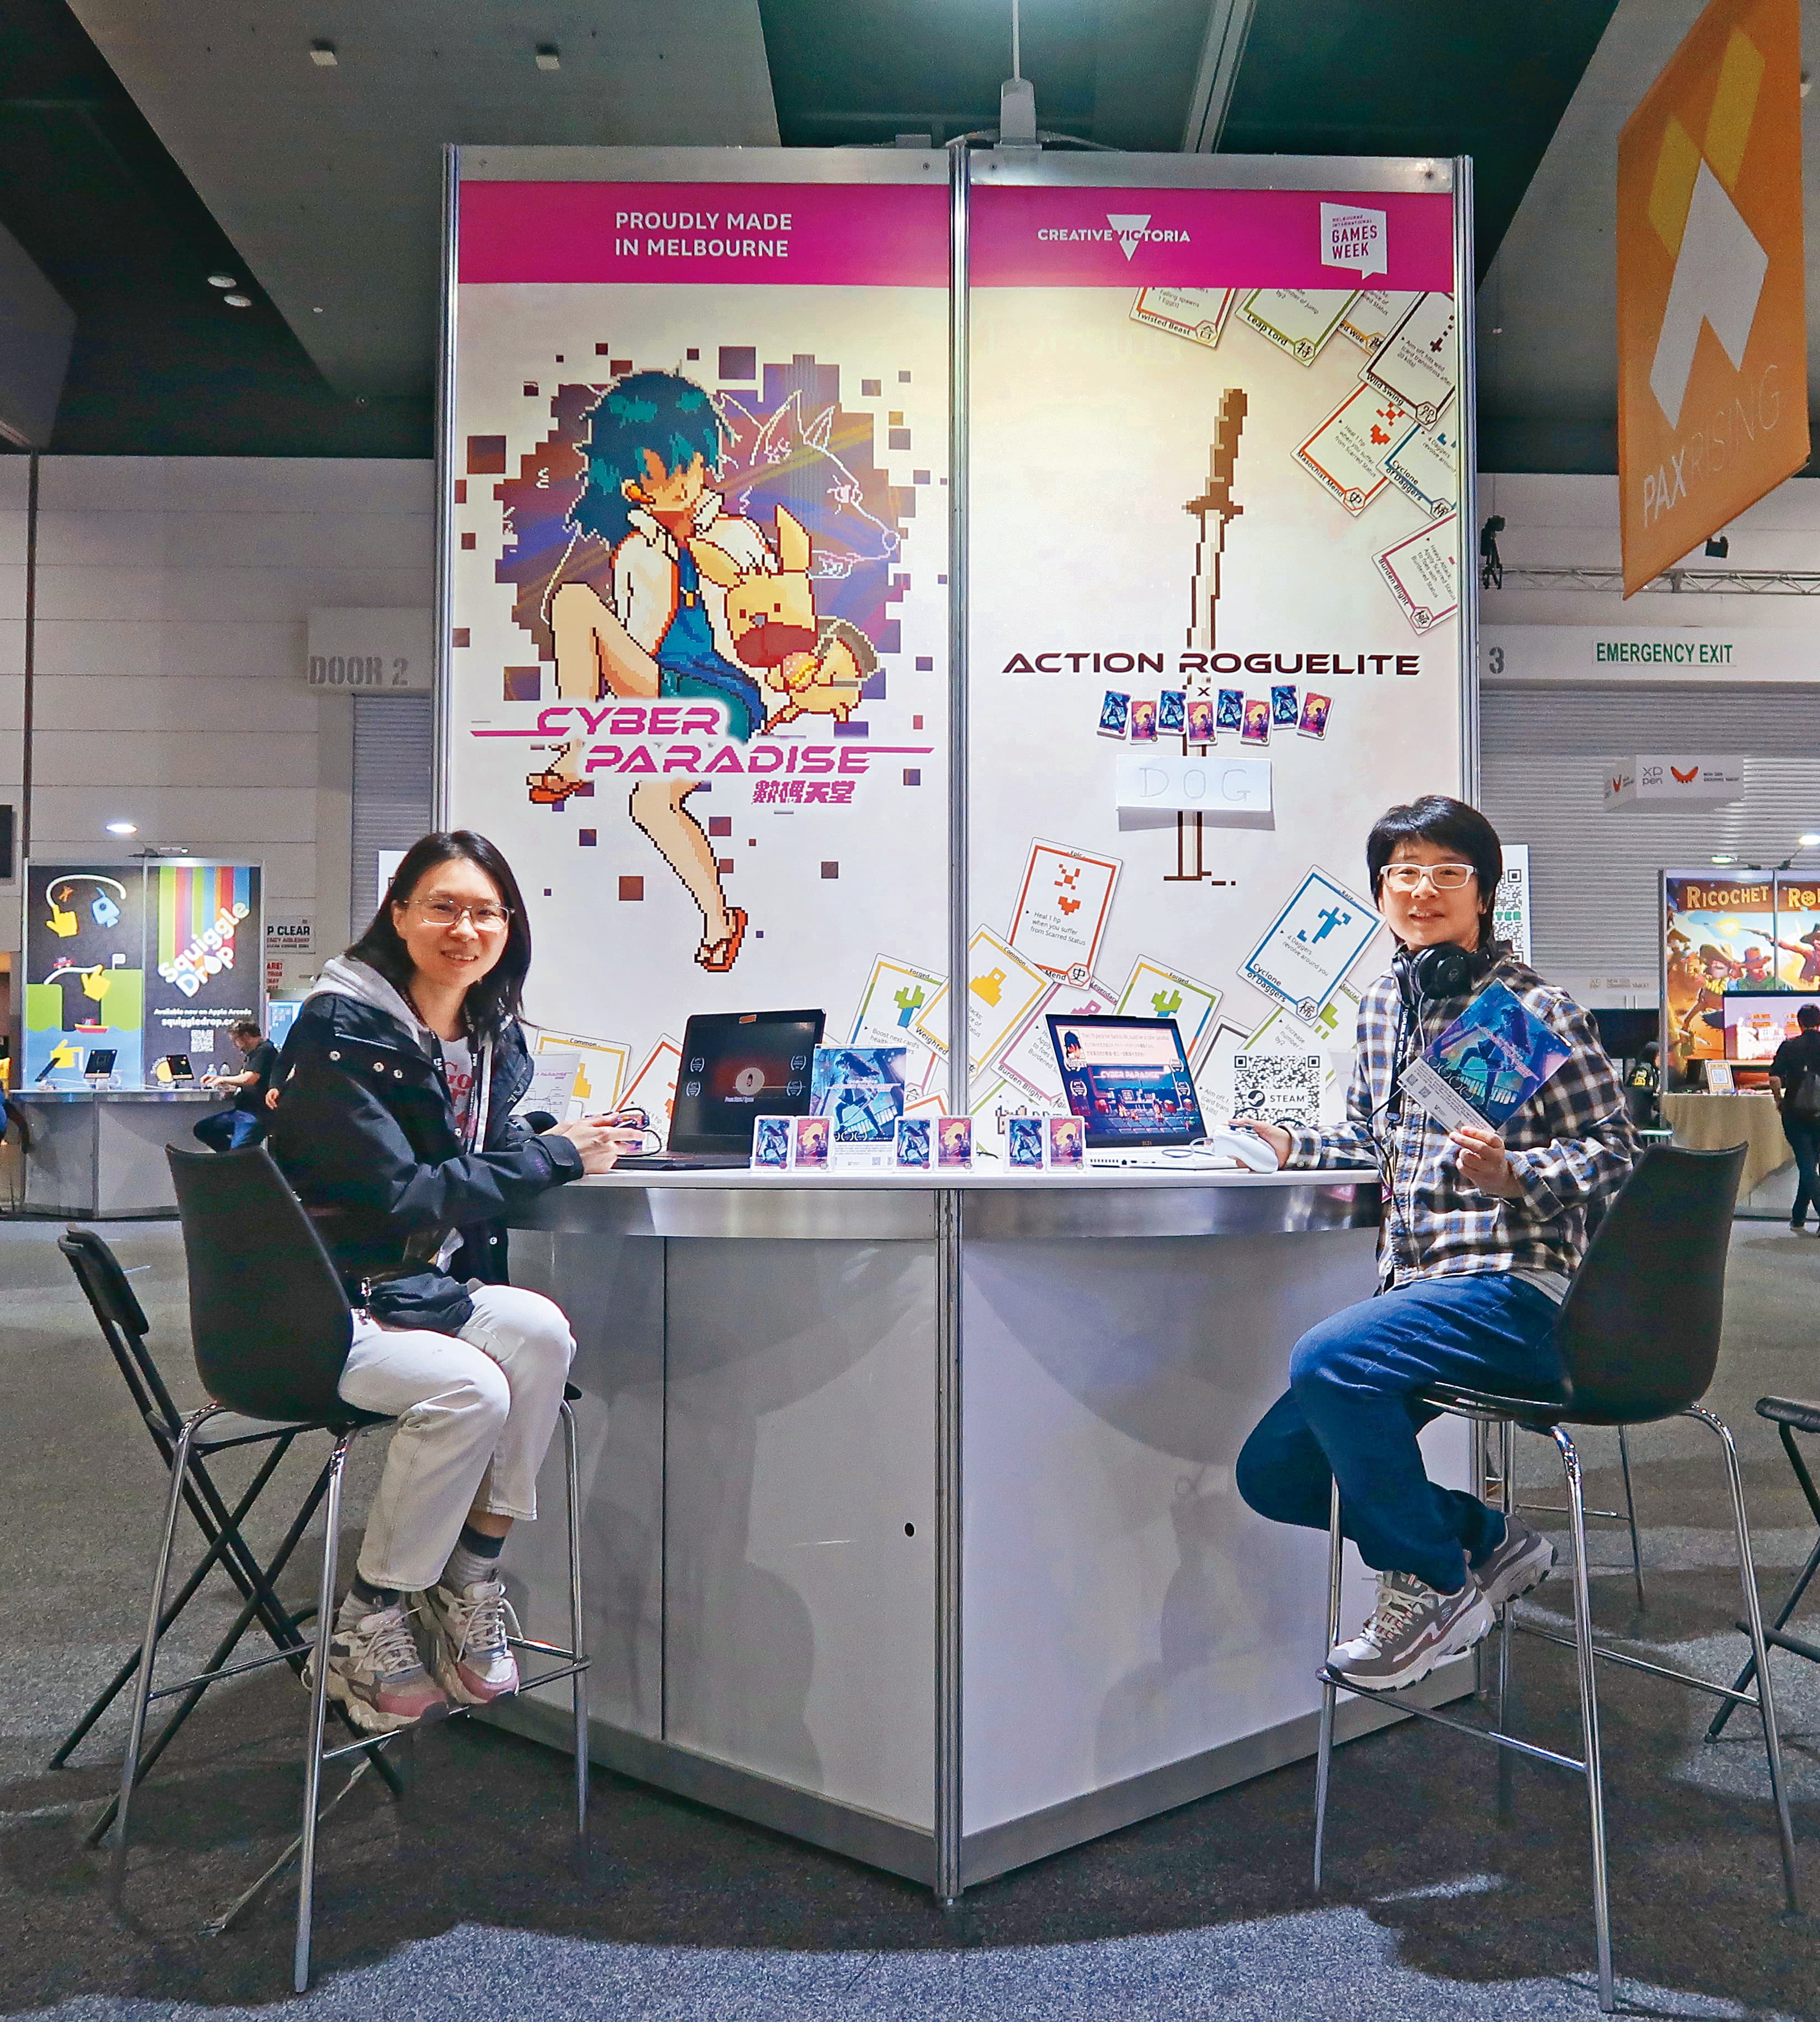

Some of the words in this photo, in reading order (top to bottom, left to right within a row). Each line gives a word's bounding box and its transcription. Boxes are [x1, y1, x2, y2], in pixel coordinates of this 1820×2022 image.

[615, 212, 719, 230] PROUDLY
[727, 213, 793, 231] MADE
[1037, 228, 1113, 241] CREATIVE
[1115, 229, 1191, 242] VICTORIA
[1332, 225, 1378, 243] GAMES
[615, 239, 638, 256] IN
[648, 239, 788, 257] MELBOURNE
[1332, 242, 1369, 259] WEEK
[1137, 312, 1168, 327] Twisted
[1169, 323, 1191, 336] Beast
[1247, 313, 1267, 333] Leap
[1268, 328, 1288, 347] Lord
[1366, 374, 1383, 390] Wild
[1382, 385, 1405, 407] Swing
[1296, 451, 1327, 482] Masochist
[1326, 477, 1344, 497] Mend
[1392, 459, 1419, 486] Cyclone
[1385, 468, 1395, 477] of
[1393, 473, 1422, 502] Daggers
[1644, 445, 1687, 529] PAX
[1378, 558, 1396, 585] Burden
[1393, 583, 1410, 606] Blight
[1489, 646, 1505, 675] 3
[1597, 642, 1695, 663] EMERGENCY
[1700, 644, 1734, 663] EXIT
[309, 656, 383, 685] DOOR
[391, 657, 409, 686] 2
[1002, 652, 1164, 673] ACTION
[1179, 653, 1420, 676] ROGUELITE
[532, 707, 721, 737] CYBER
[585, 745, 881, 774] PARADISE
[1139, 767, 1251, 801] DOG
[1070, 850, 1083, 859] Epic
[1341, 890, 1354, 901] Rare
[1686, 885, 1770, 908] RICOCHET
[1788, 887, 1820, 908] RO
[1032, 919, 1048, 929] when
[1048, 923, 1060, 932] you
[1061, 926, 1078, 936] suffer
[1033, 911, 1048, 921] Heal
[1053, 915, 1061, 924] hp
[277, 926, 310, 936] CLEAR
[1030, 926, 1045, 936] from
[1046, 930, 1067, 941] Scarred
[1067, 936, 1087, 946] Status
[158, 902, 250, 983] Squiggle
[1291, 936, 1313, 956] Daggers
[1003, 946, 1027, 967] Common
[1282, 941, 1301, 956] revolve
[1301, 953, 1320, 970] around
[1318, 965, 1330, 977] you
[175, 946, 234, 998] Drop
[909, 968, 930, 980] Forged
[1044, 969, 1067, 981] Mend
[1070, 967, 1085, 984] 史
[1169, 972, 1189, 985] Forged
[1253, 963, 1282, 987] Cyclone
[1090, 981, 1118, 1005] Legendary
[1247, 971, 1257, 980] of
[1255, 977, 1287, 1003] Daggers
[1341, 983, 1359, 1000] Special
[569, 1037, 597, 1047] Common
[872, 1028, 889, 1039] Boost
[889, 1034, 904, 1044] next
[915, 1027, 949, 1056] Weighted
[1280, 1030, 1299, 1049] number
[1284, 1024, 1306, 1044] Increase
[1027, 1048, 1052, 1071] Burdened
[997, 1064, 1022, 1087] Burden
[1021, 1083, 1043, 1102] Blight
[1200, 1095, 1215, 1106] (card
[1215, 1101, 1229, 1113] trans
[1204, 1089, 1216, 1099] Aim
